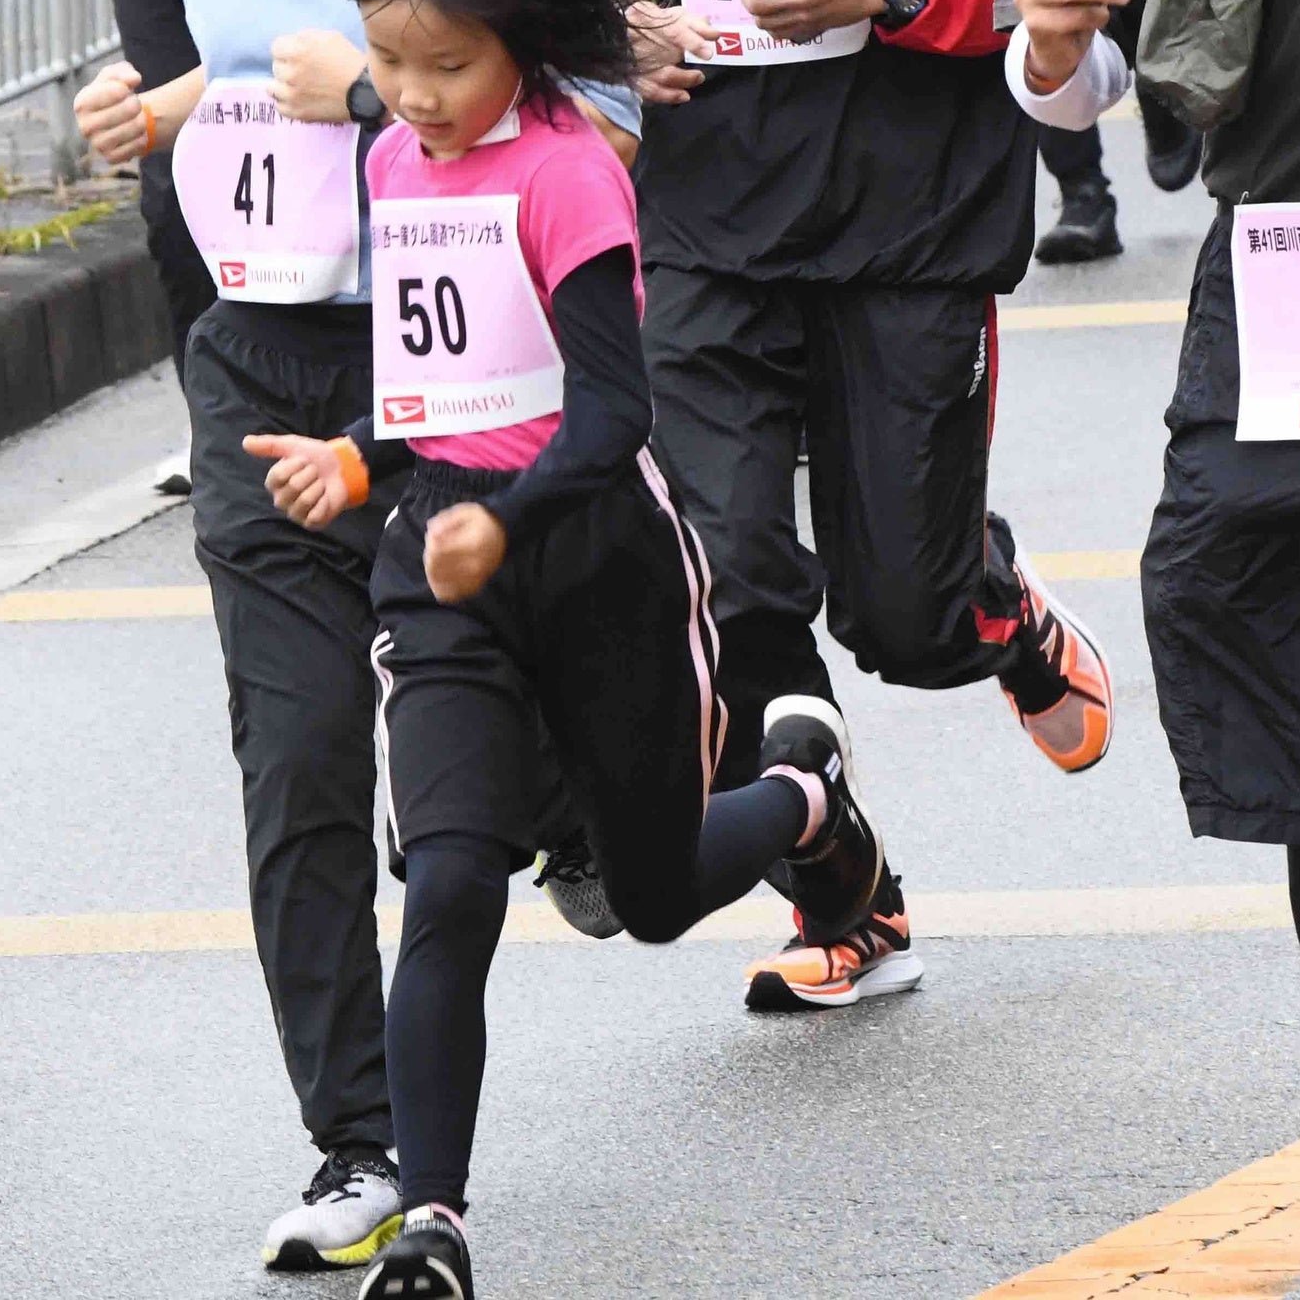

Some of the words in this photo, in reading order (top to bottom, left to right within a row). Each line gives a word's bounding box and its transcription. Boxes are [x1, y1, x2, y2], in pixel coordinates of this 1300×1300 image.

[233, 152, 276, 226] 41
[397, 274, 468, 356] 50
[430, 392, 516, 416] DAIHATSU
